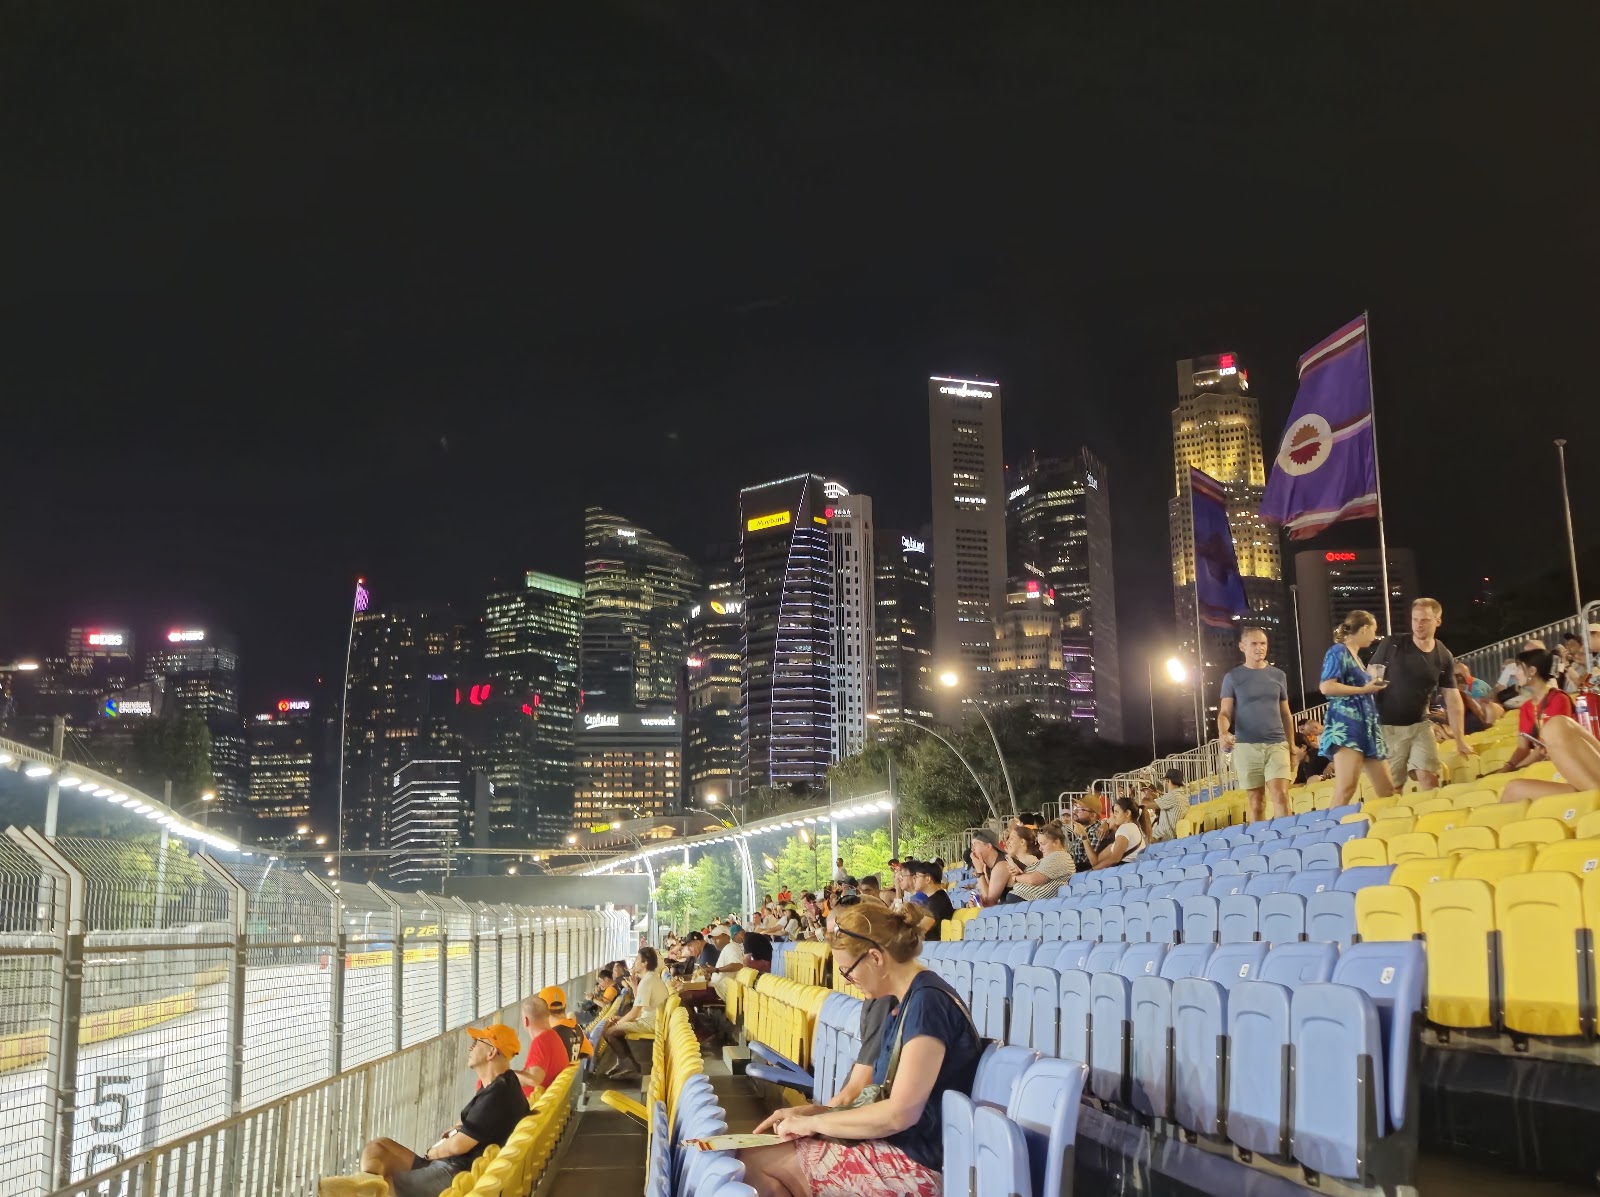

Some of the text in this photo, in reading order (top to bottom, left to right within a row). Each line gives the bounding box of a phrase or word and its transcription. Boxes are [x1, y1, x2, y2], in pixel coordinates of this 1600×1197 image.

[100, 634, 122, 645] DBS
[585, 713, 620, 727] CapitaLand
[641, 716, 677, 726] wework
[403, 926, 415, 938] P
